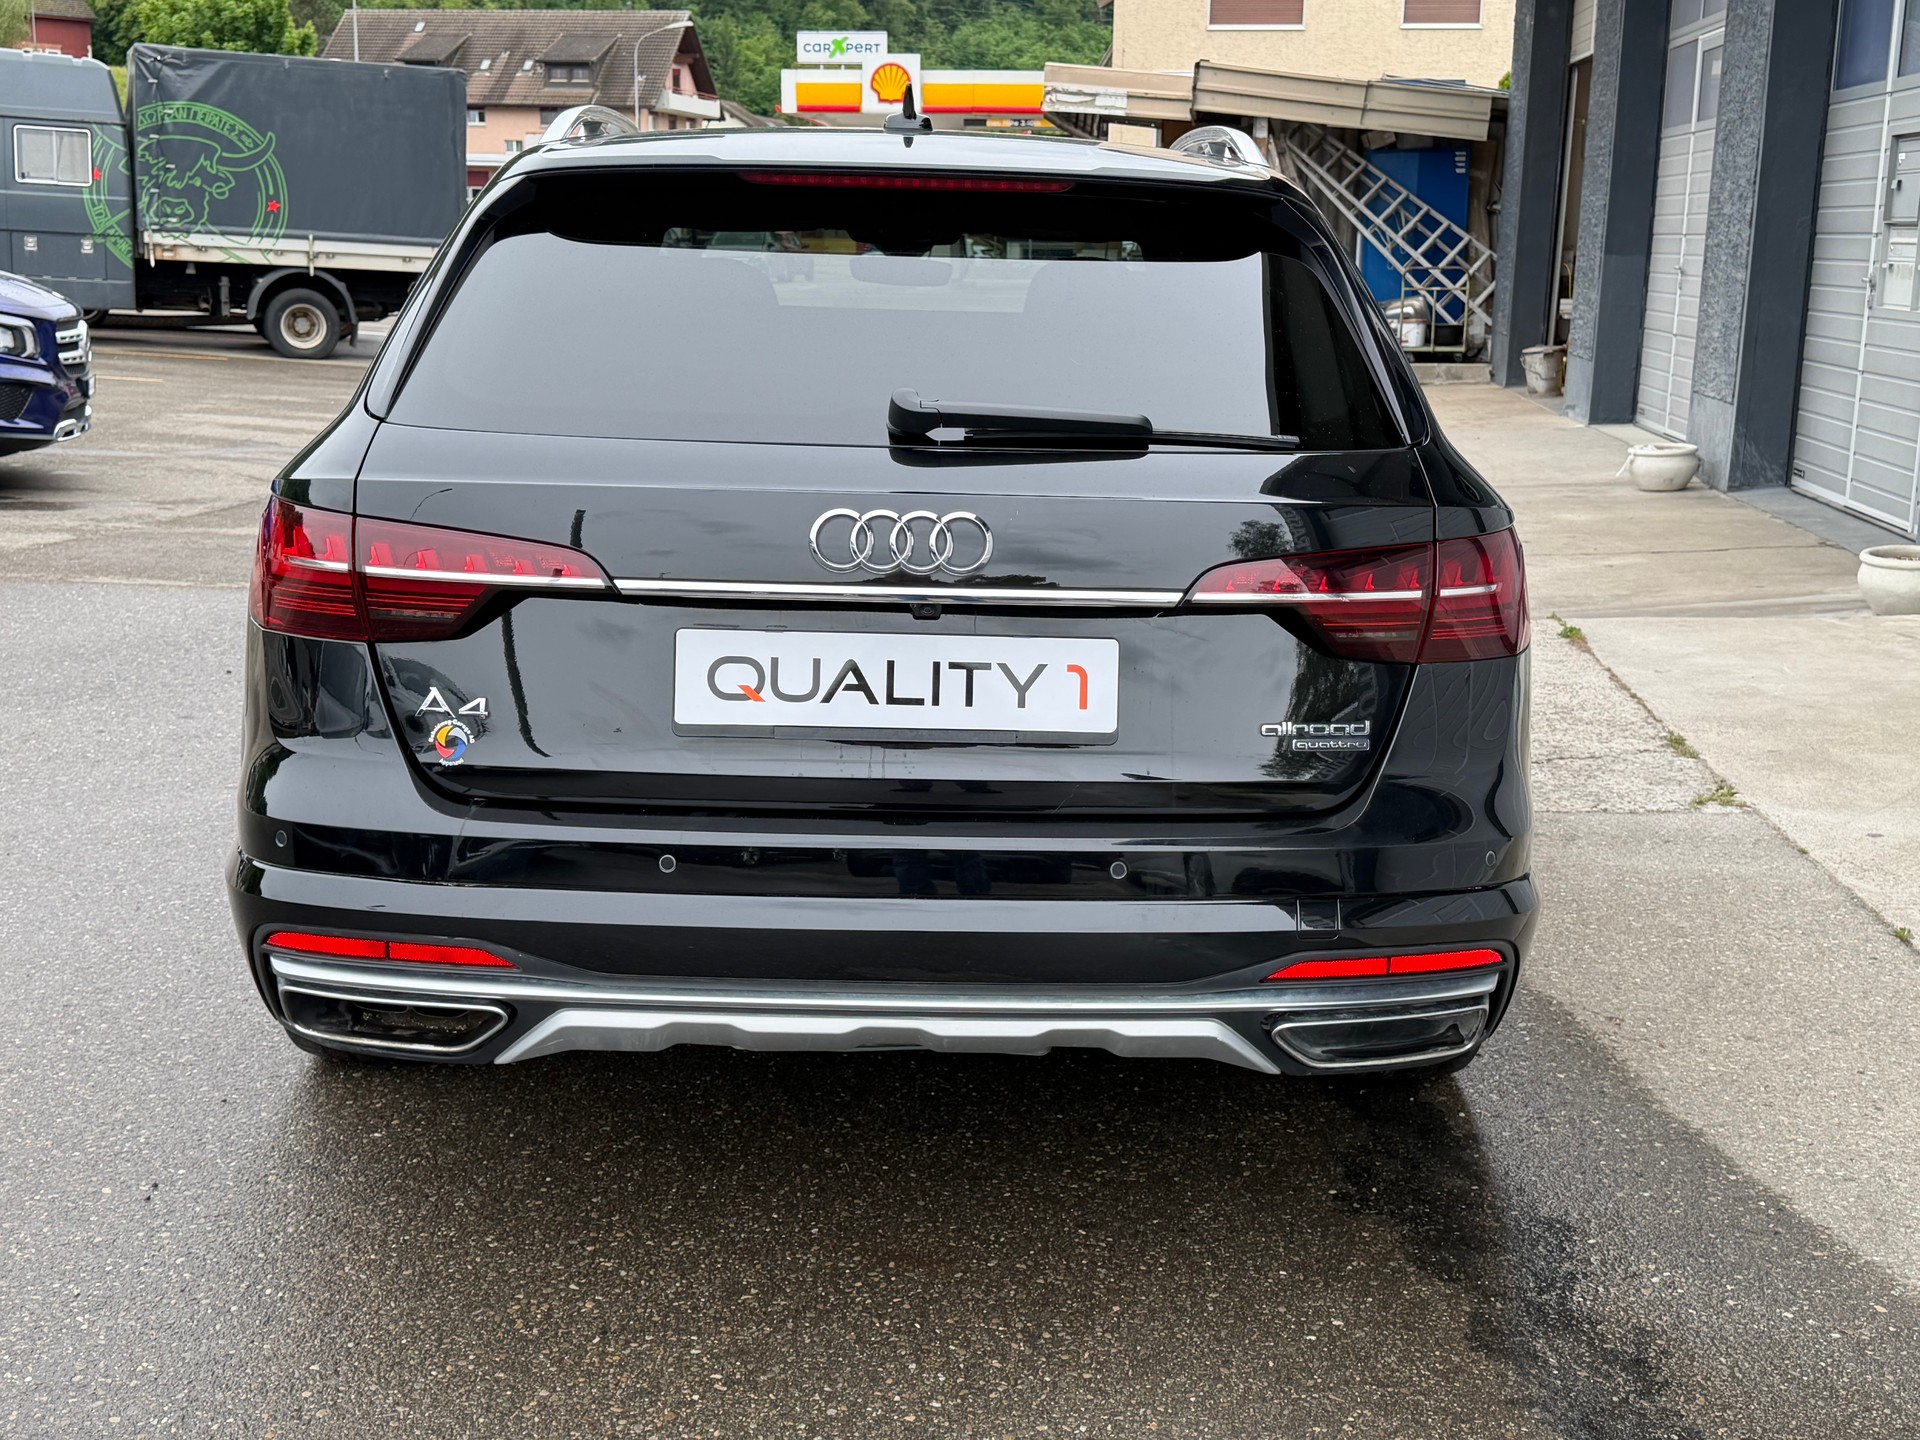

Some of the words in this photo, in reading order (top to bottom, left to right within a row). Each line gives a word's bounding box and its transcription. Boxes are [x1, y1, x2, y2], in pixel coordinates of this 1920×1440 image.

[707, 655, 1048, 709] QUALITY
[415, 686, 489, 719] A4
[1261, 720, 1370, 736] allroad
[1296, 740, 1367, 750] quattro
